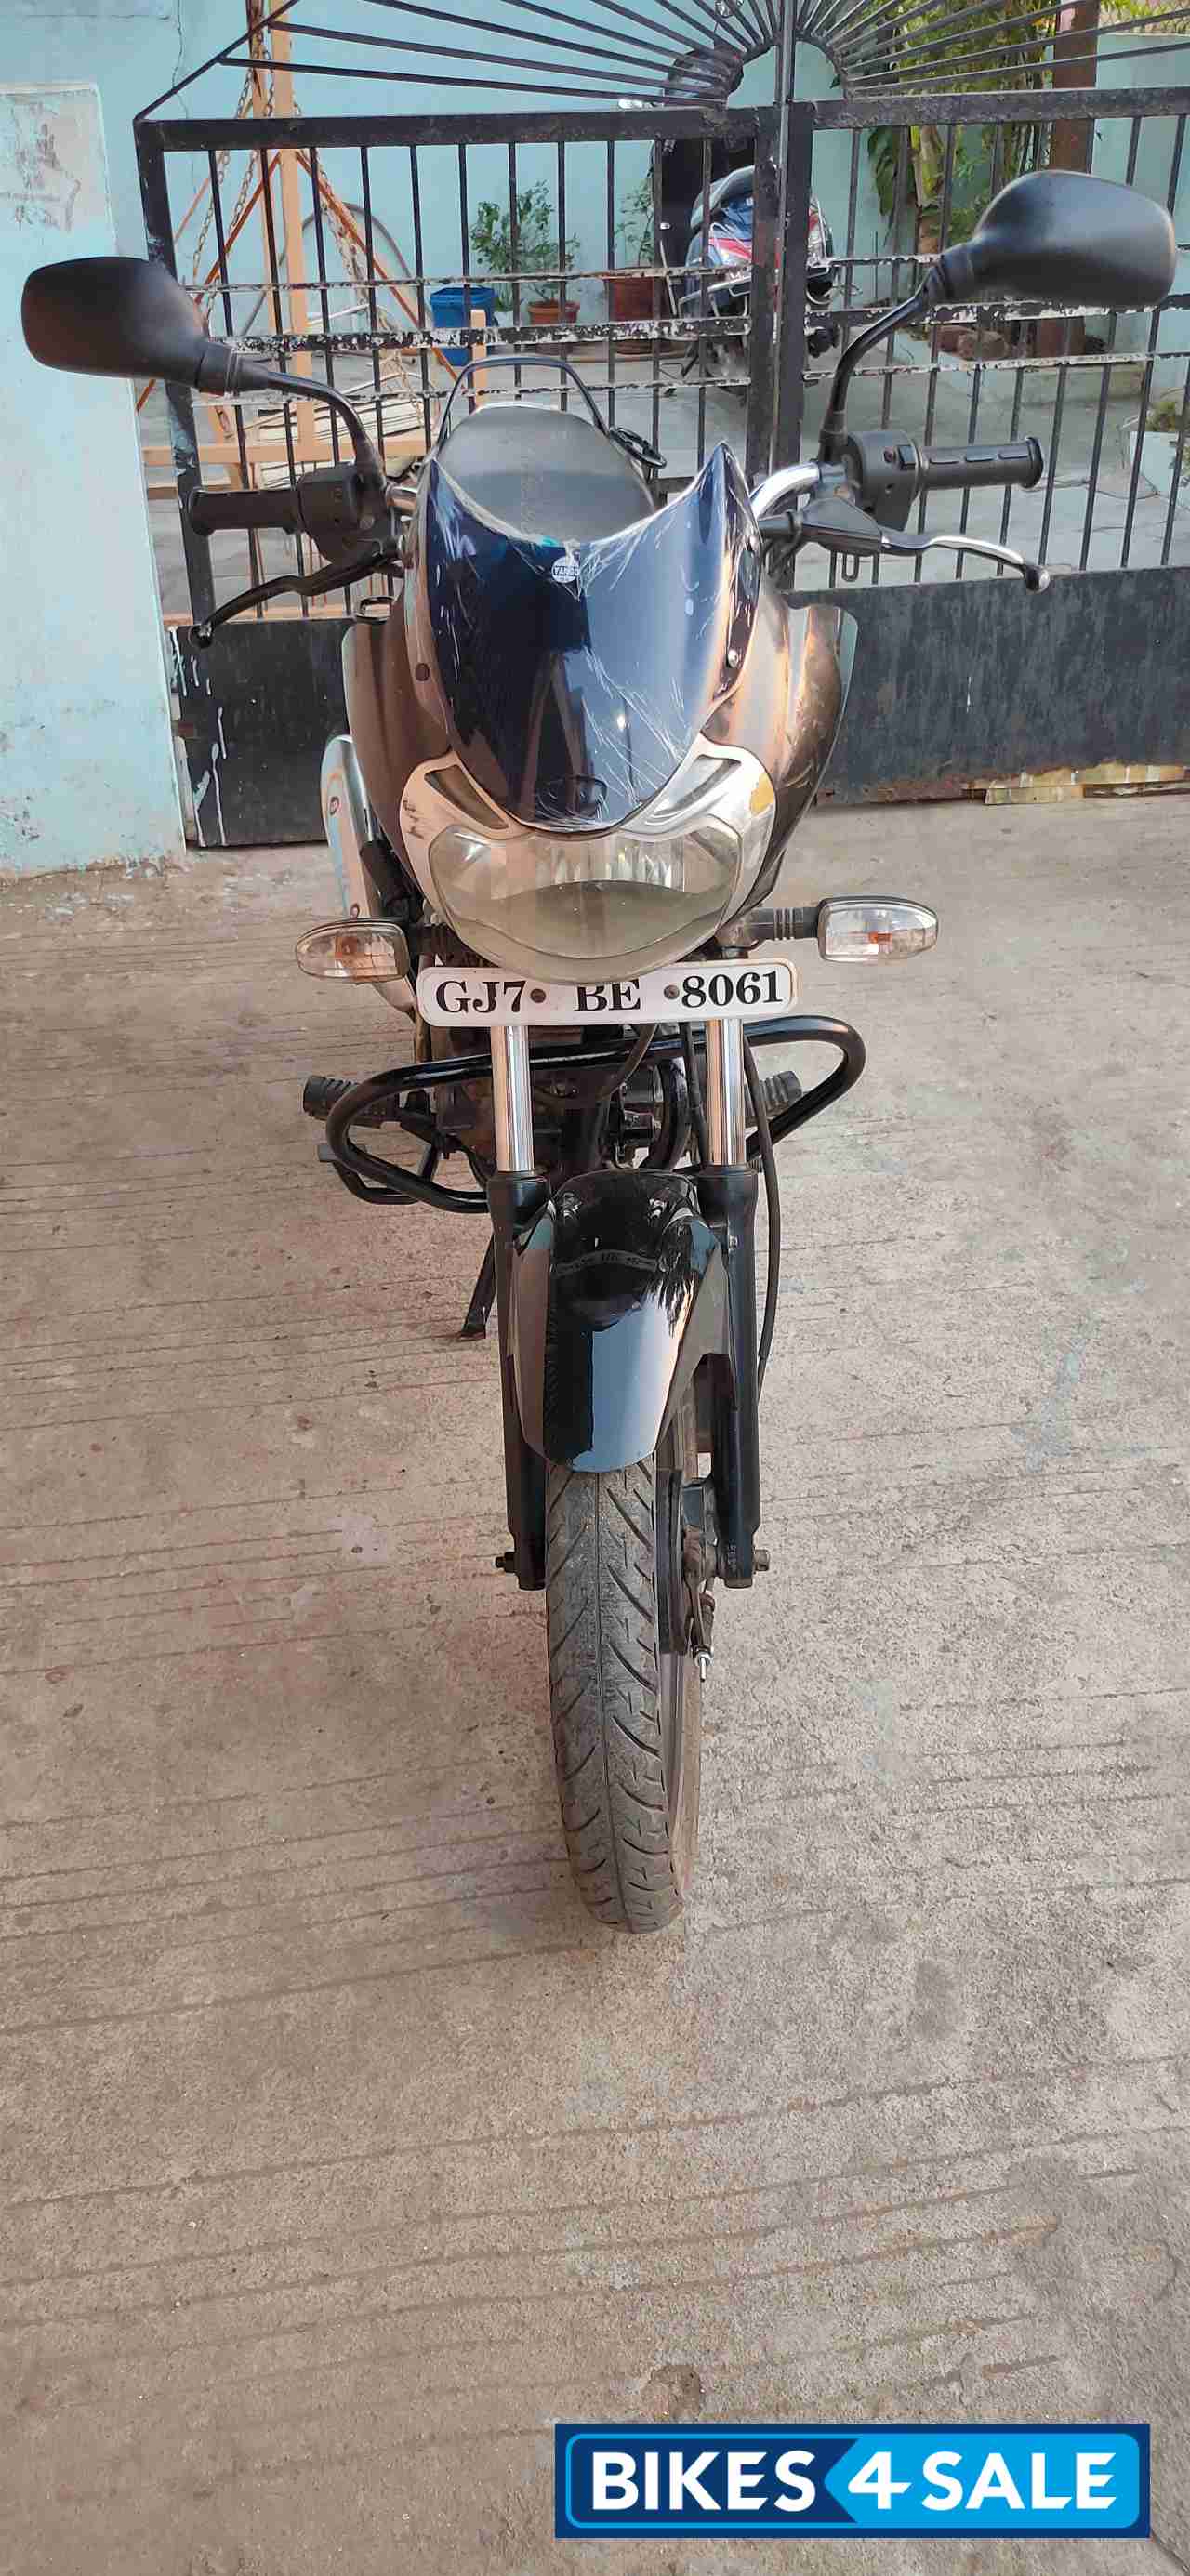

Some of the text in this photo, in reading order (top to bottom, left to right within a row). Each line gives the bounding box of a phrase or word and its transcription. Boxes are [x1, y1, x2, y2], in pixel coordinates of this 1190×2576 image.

[435, 971, 783, 1013] GJ7 BE 8061
